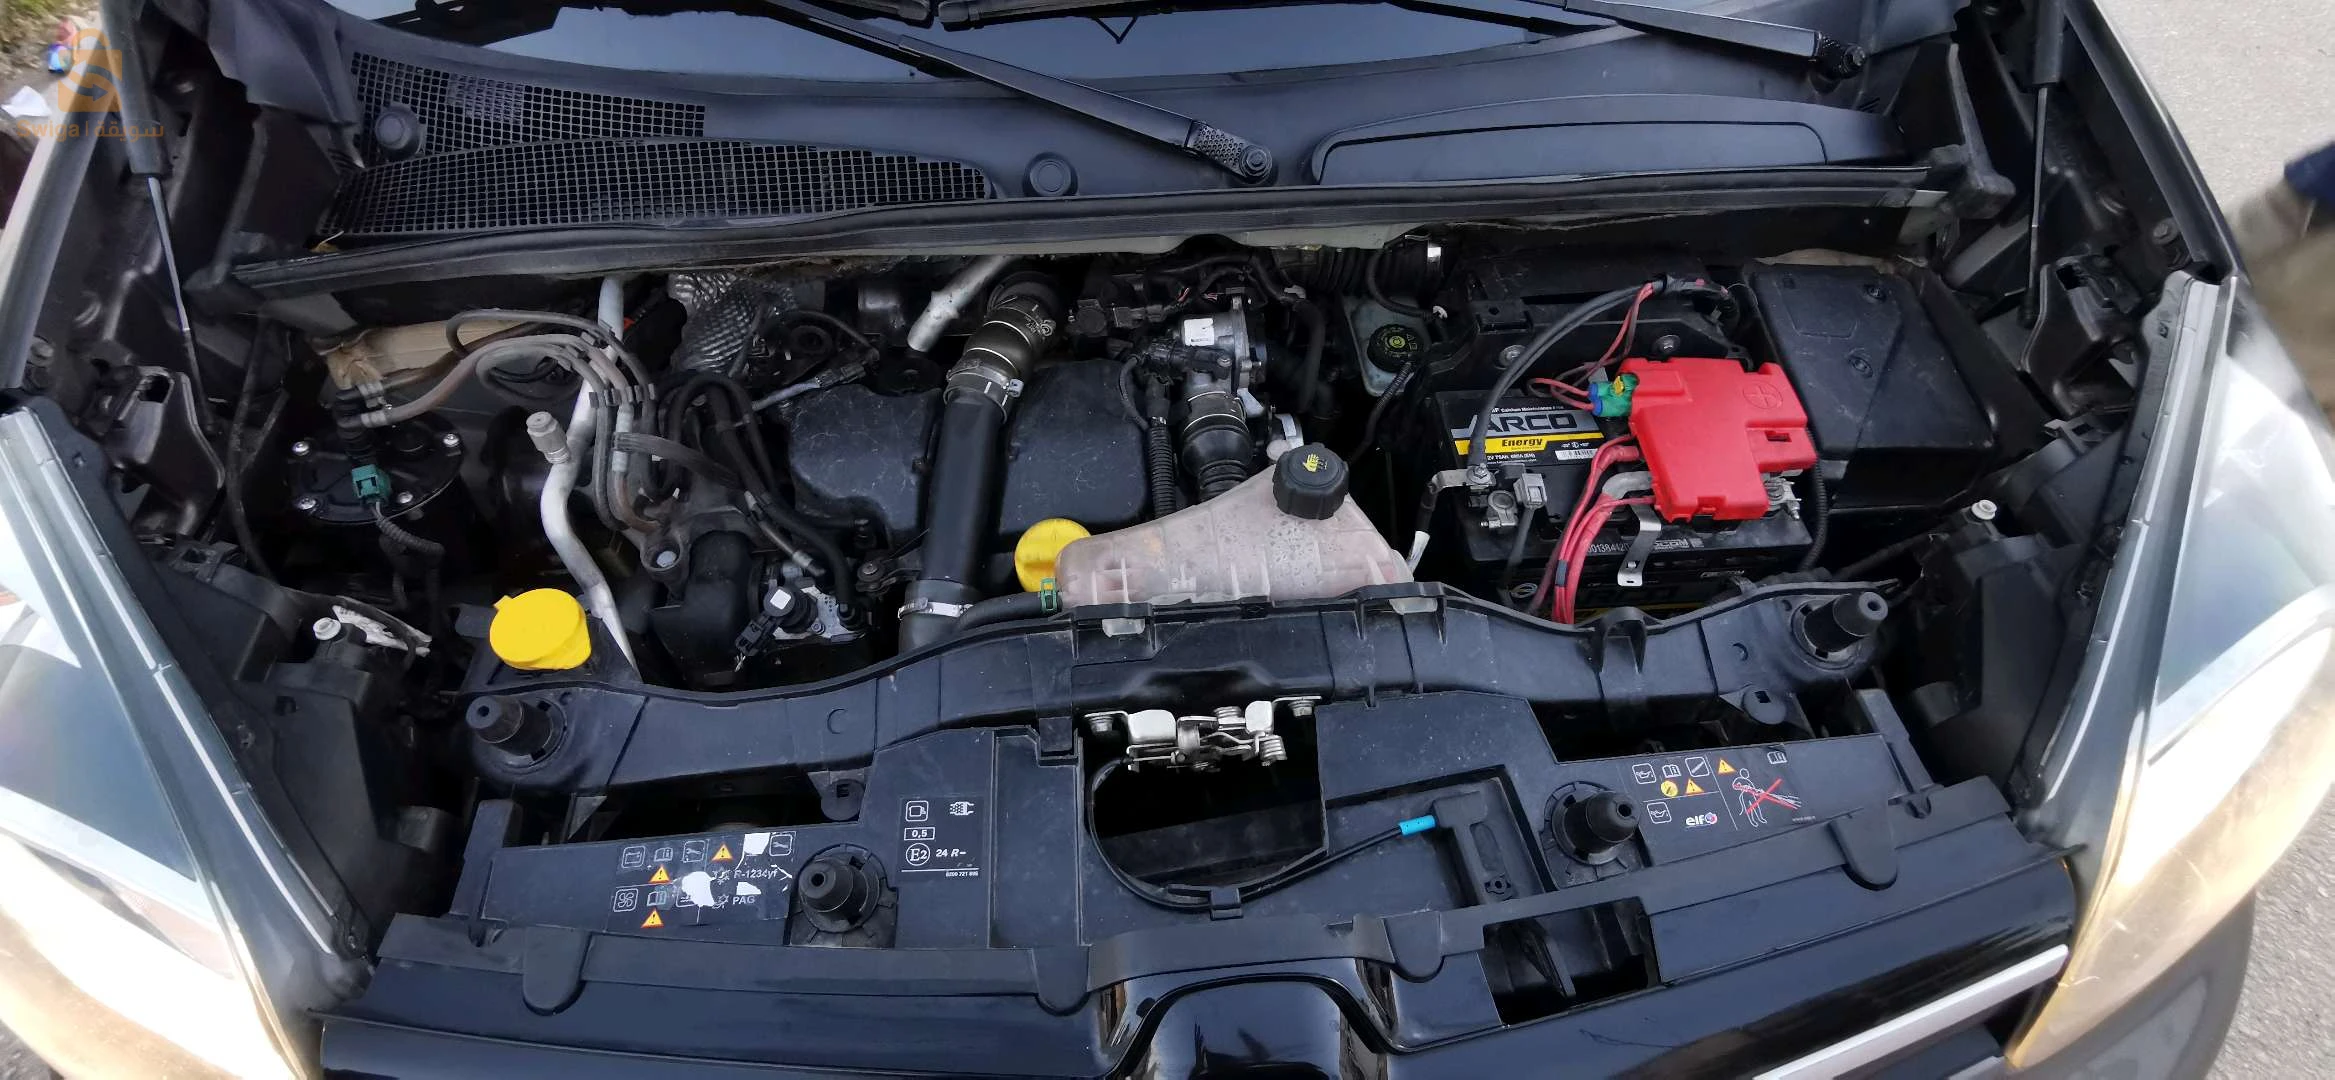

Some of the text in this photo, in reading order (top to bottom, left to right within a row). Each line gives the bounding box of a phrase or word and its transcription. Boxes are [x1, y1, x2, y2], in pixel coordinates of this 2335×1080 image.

[1502, 438, 1543, 447] Energy
[1686, 814, 1704, 826] elf
[911, 829, 928, 839] 0,5
[909, 848, 928, 862] E2
[935, 848, 948, 857] 24
[733, 868, 778, 880] R-1234yf
[732, 895, 756, 905] PAG
